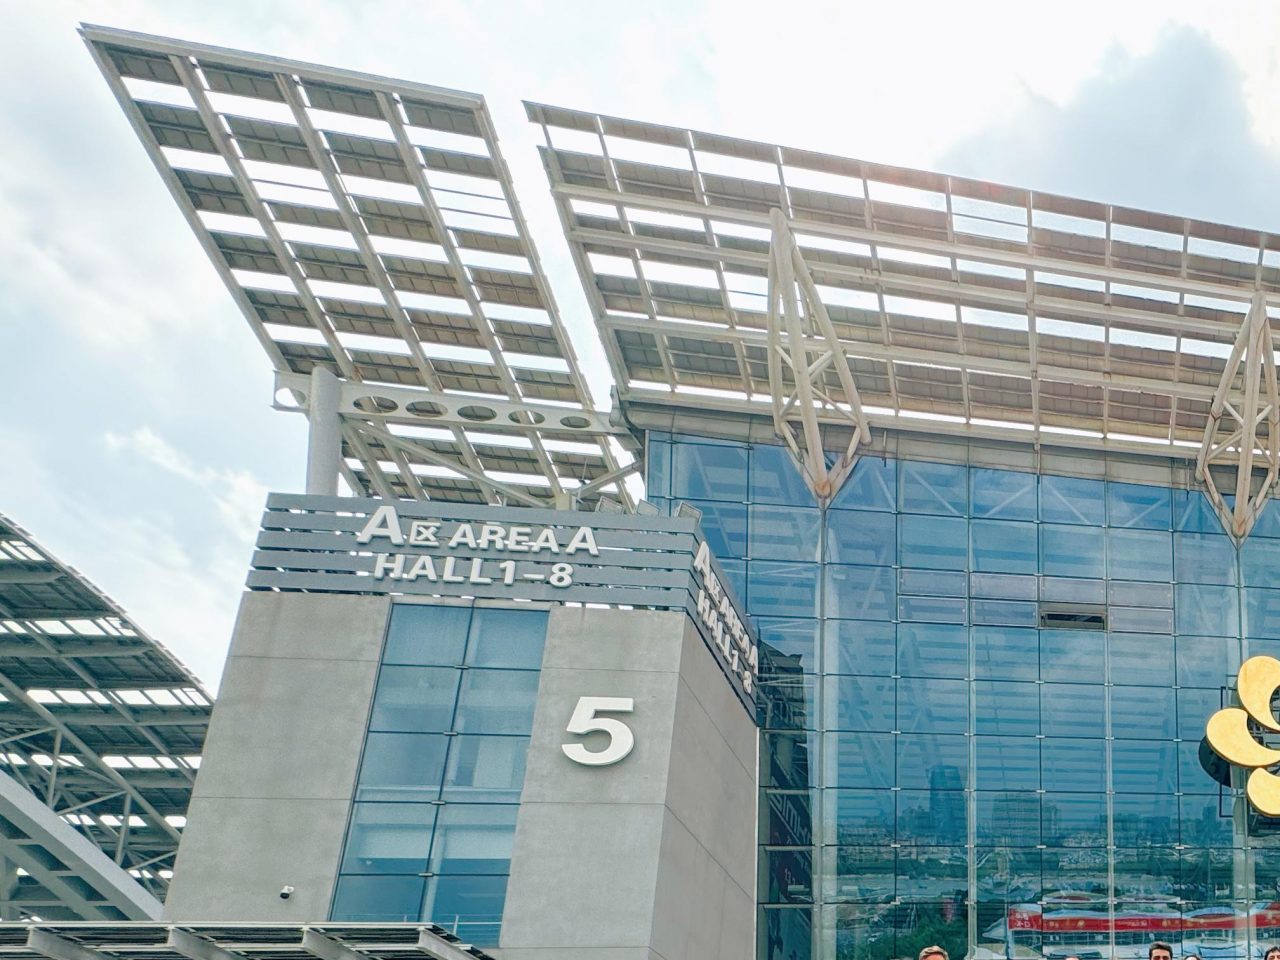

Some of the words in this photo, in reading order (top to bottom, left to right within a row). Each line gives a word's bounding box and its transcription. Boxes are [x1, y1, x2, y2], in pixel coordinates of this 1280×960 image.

[374, 554, 492, 585] HALL
[448, 523, 560, 554] AREA
[565, 526, 600, 557] A
[697, 589, 733, 665] HALL
[719, 596, 751, 659] AREA
[561, 696, 634, 766] 5
